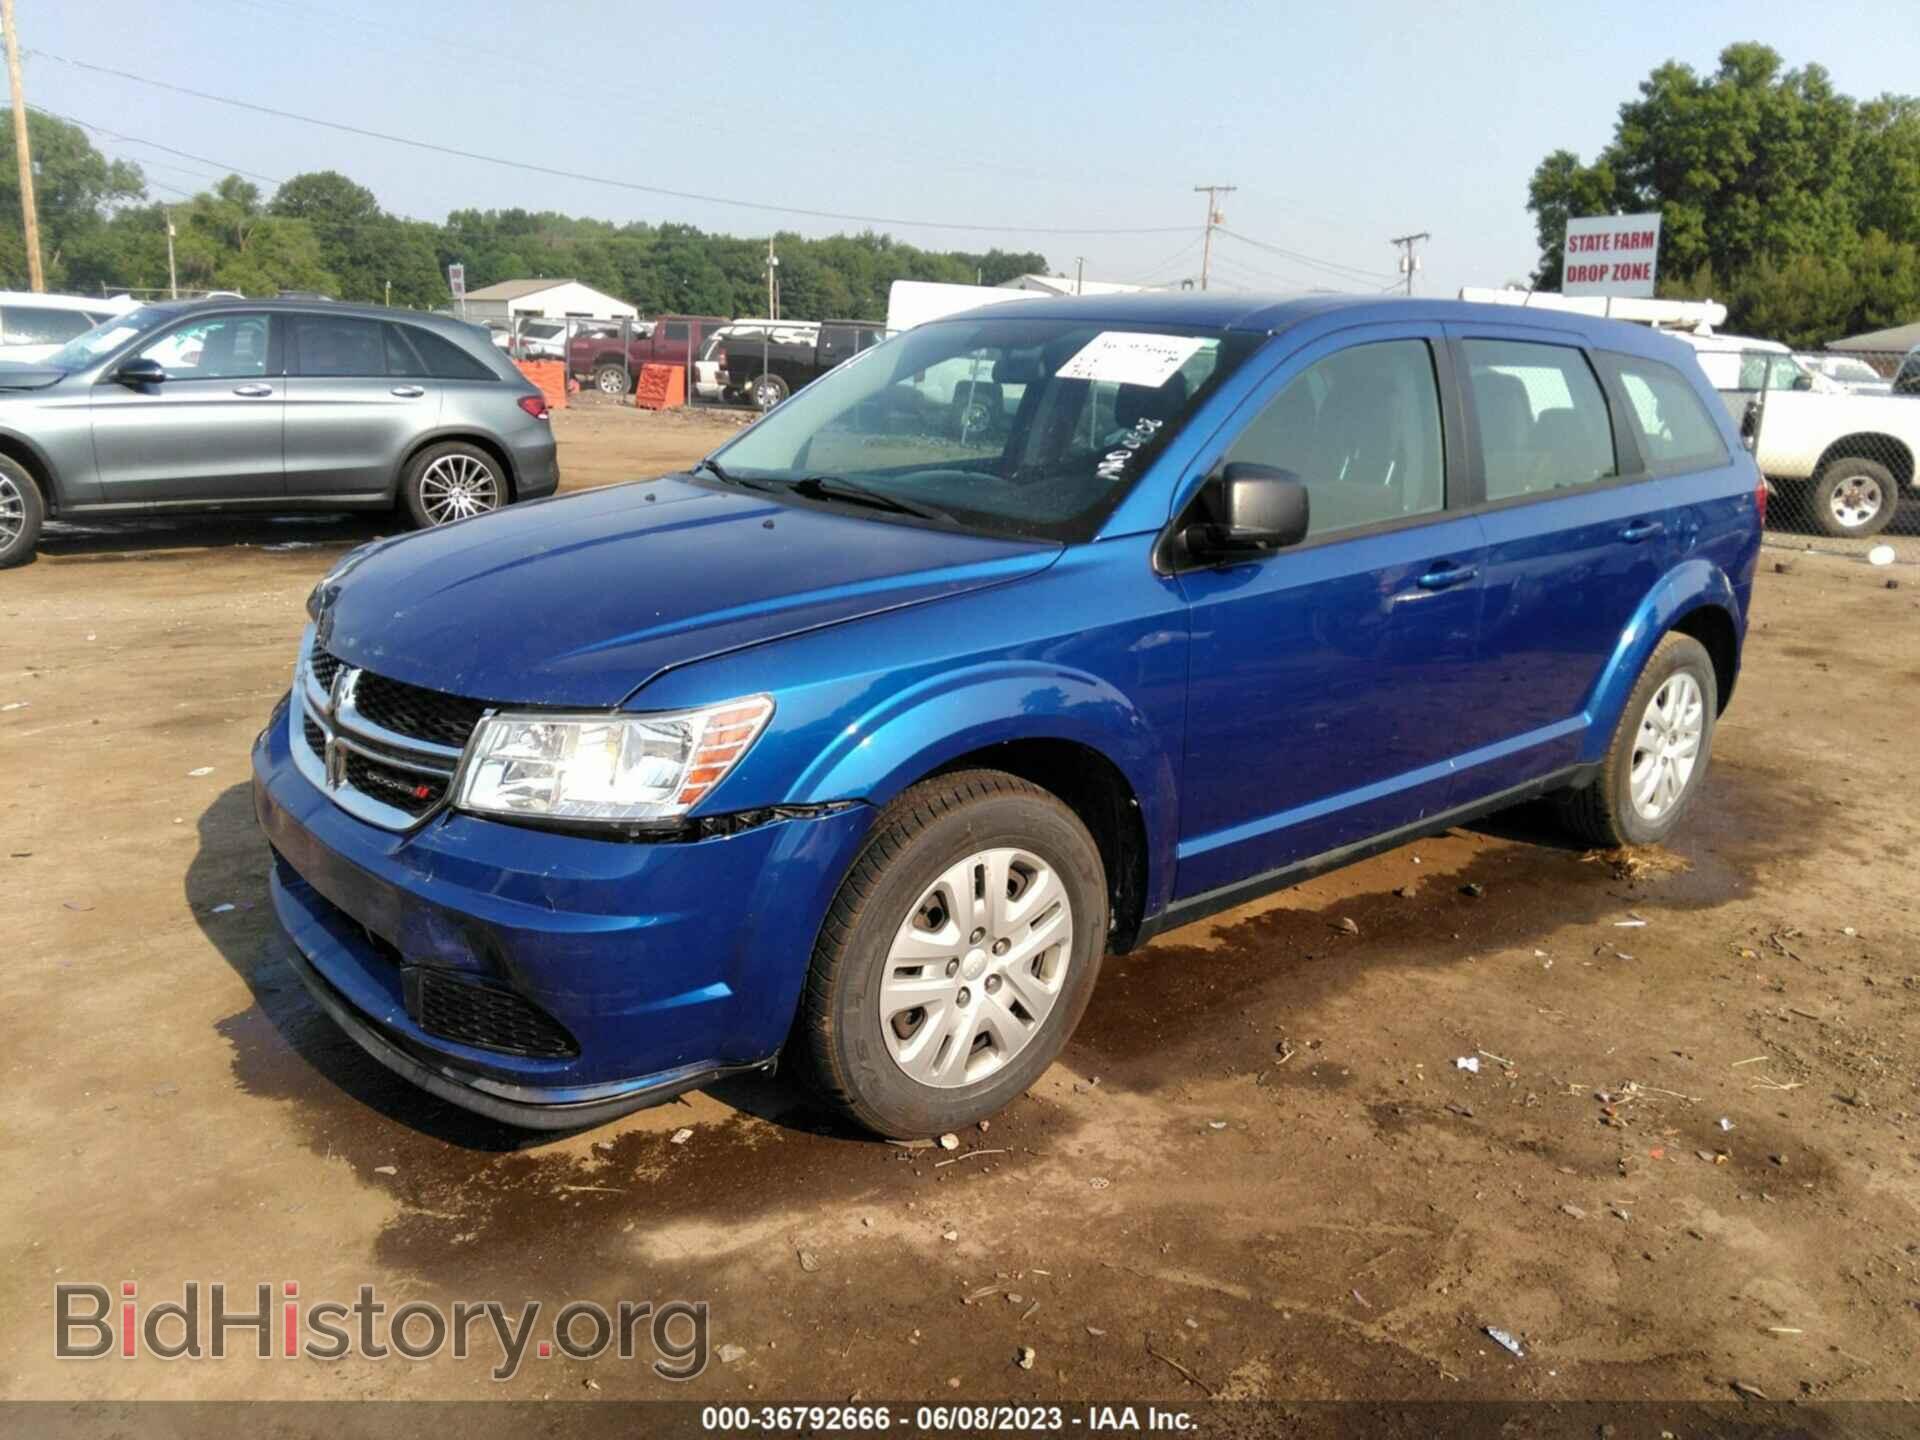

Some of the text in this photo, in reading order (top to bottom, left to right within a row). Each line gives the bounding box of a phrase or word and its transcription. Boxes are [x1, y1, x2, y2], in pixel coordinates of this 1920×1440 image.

[1569, 232, 1654, 252] STATE FARM
[1568, 263, 1651, 282] DROP ZONE
